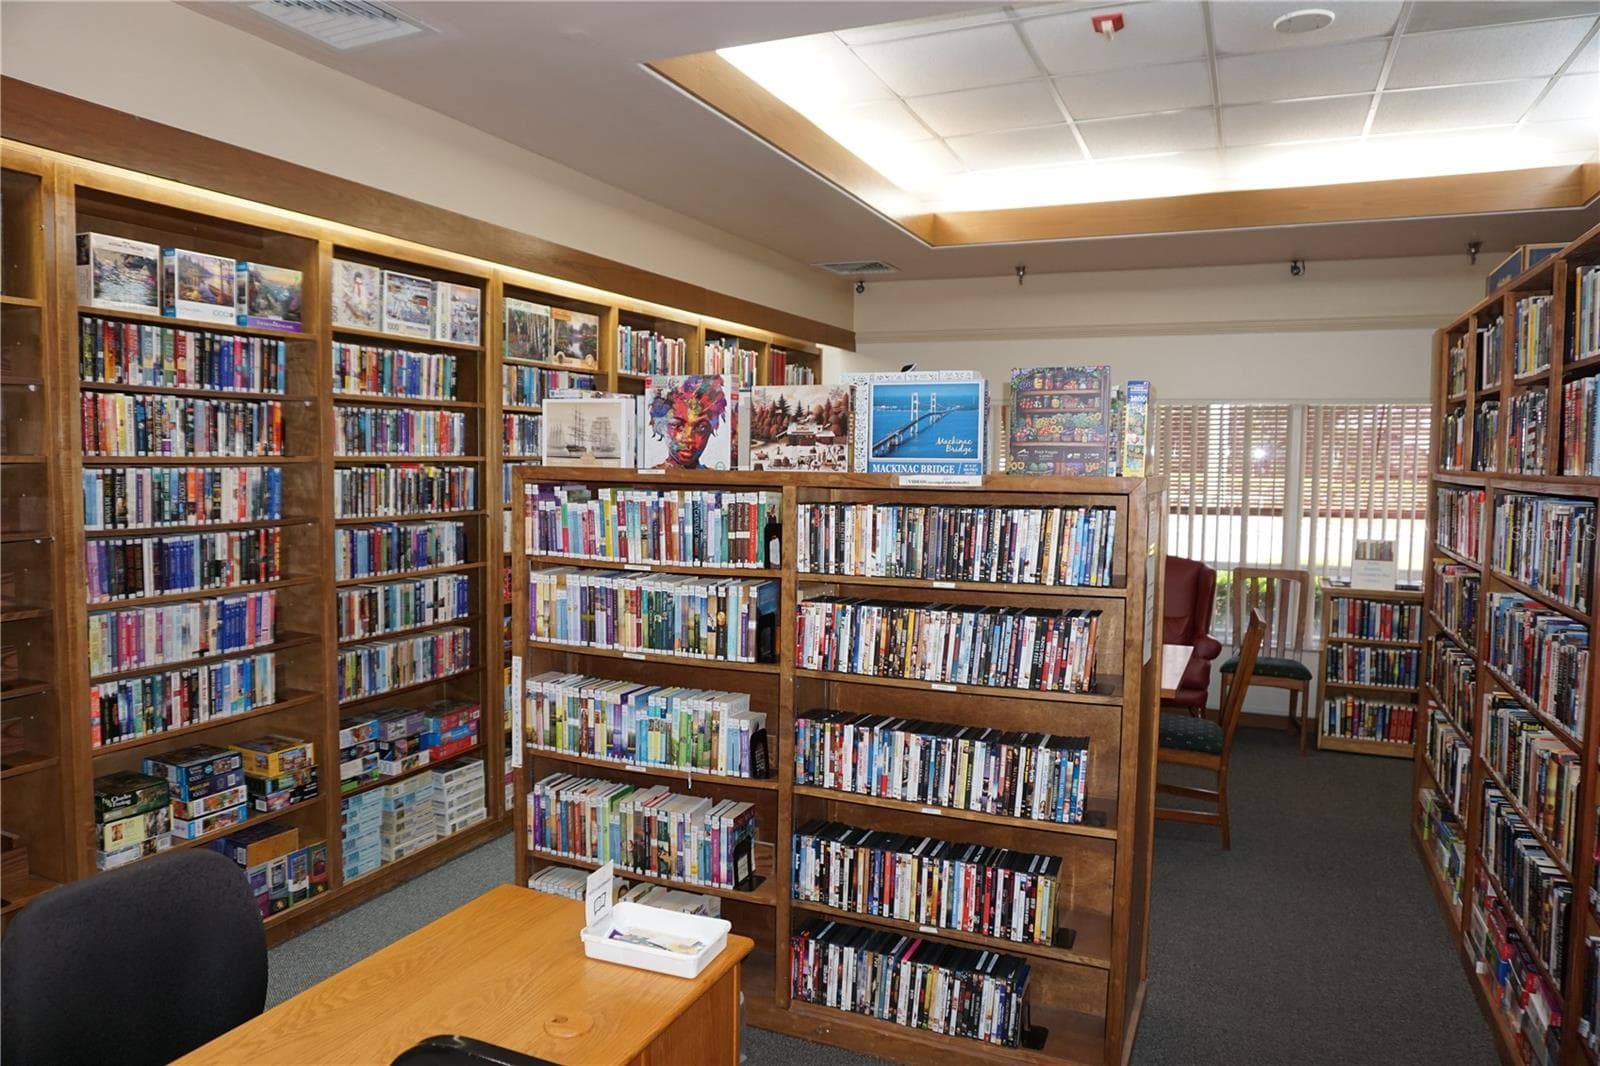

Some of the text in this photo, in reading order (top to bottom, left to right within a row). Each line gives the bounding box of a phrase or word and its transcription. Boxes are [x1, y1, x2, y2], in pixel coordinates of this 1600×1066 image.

[935, 435, 973, 446] Mackinac
[945, 444, 973, 456] Bridge
[872, 463, 919, 473] MACKINAC
[921, 464, 955, 474] BRIDGE
